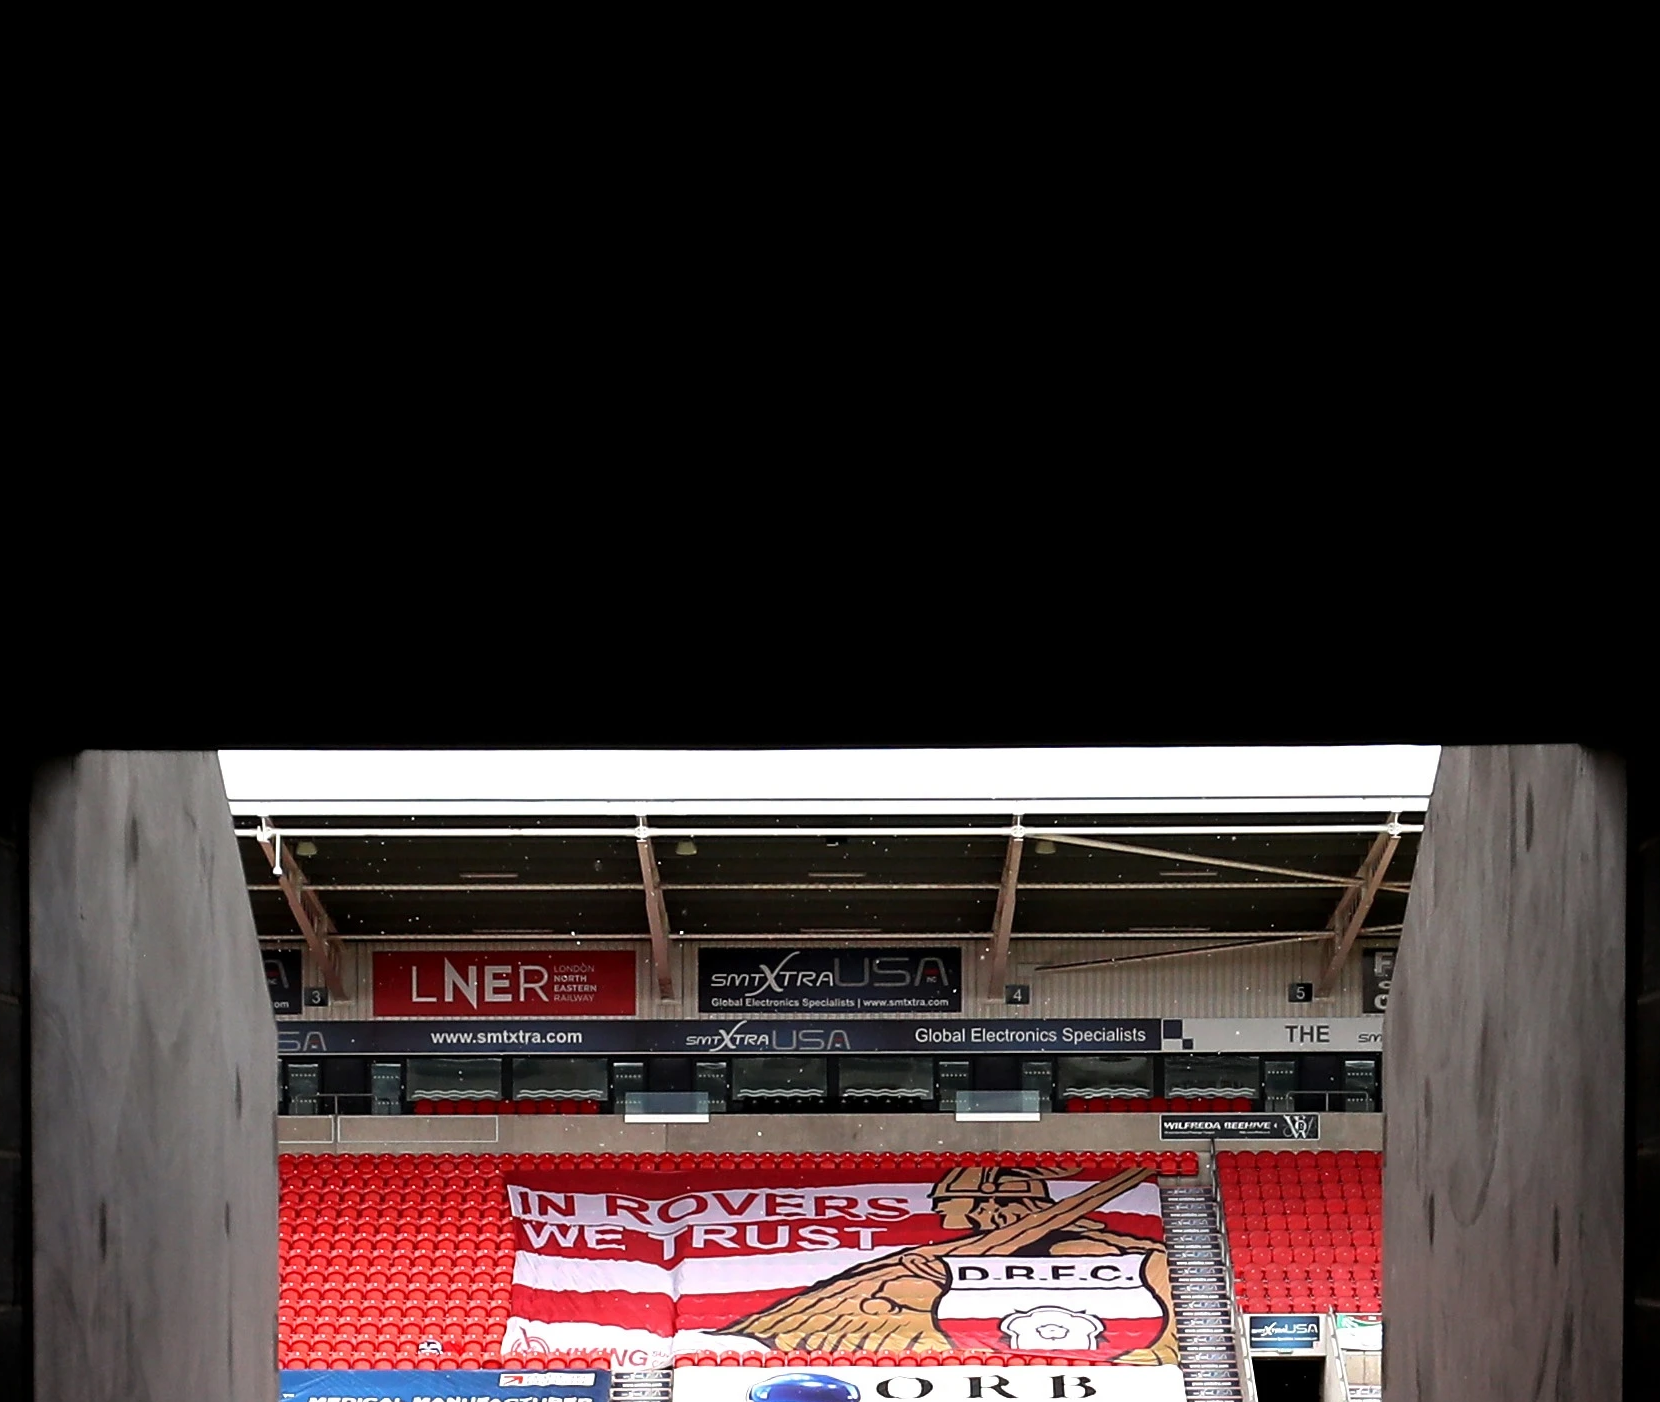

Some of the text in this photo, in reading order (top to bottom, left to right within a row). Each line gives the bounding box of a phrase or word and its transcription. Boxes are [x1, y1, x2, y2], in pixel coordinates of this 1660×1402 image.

[553, 964, 595, 973] LONDON
[834, 957, 949, 987] USA
[412, 957, 549, 1010] LNER
[553, 974, 587, 983] NORTH
[553, 984, 598, 992] EASTERN
[1013, 989, 1022, 1001] 4
[1296, 986, 1306, 1000] 5
[311, 990, 321, 1004] 3
[553, 993, 595, 1002] RAILWAY
[711, 998, 949, 1008] Global Electronics Specialists www.smtxtra.com
[431, 1030, 582, 1044] www.smtxtra.com
[772, 1030, 851, 1050] USA
[915, 1028, 1146, 1045] Global Electronics Specialists
[1285, 1025, 1330, 1042] THE
[1164, 1121, 1271, 1130] WILFREDA BEEHIVE
[519, 1191, 911, 1226] IN ROVERS
[523, 1222, 888, 1260] WE TRUST
[958, 1264, 1134, 1282] D.R.F.C.
